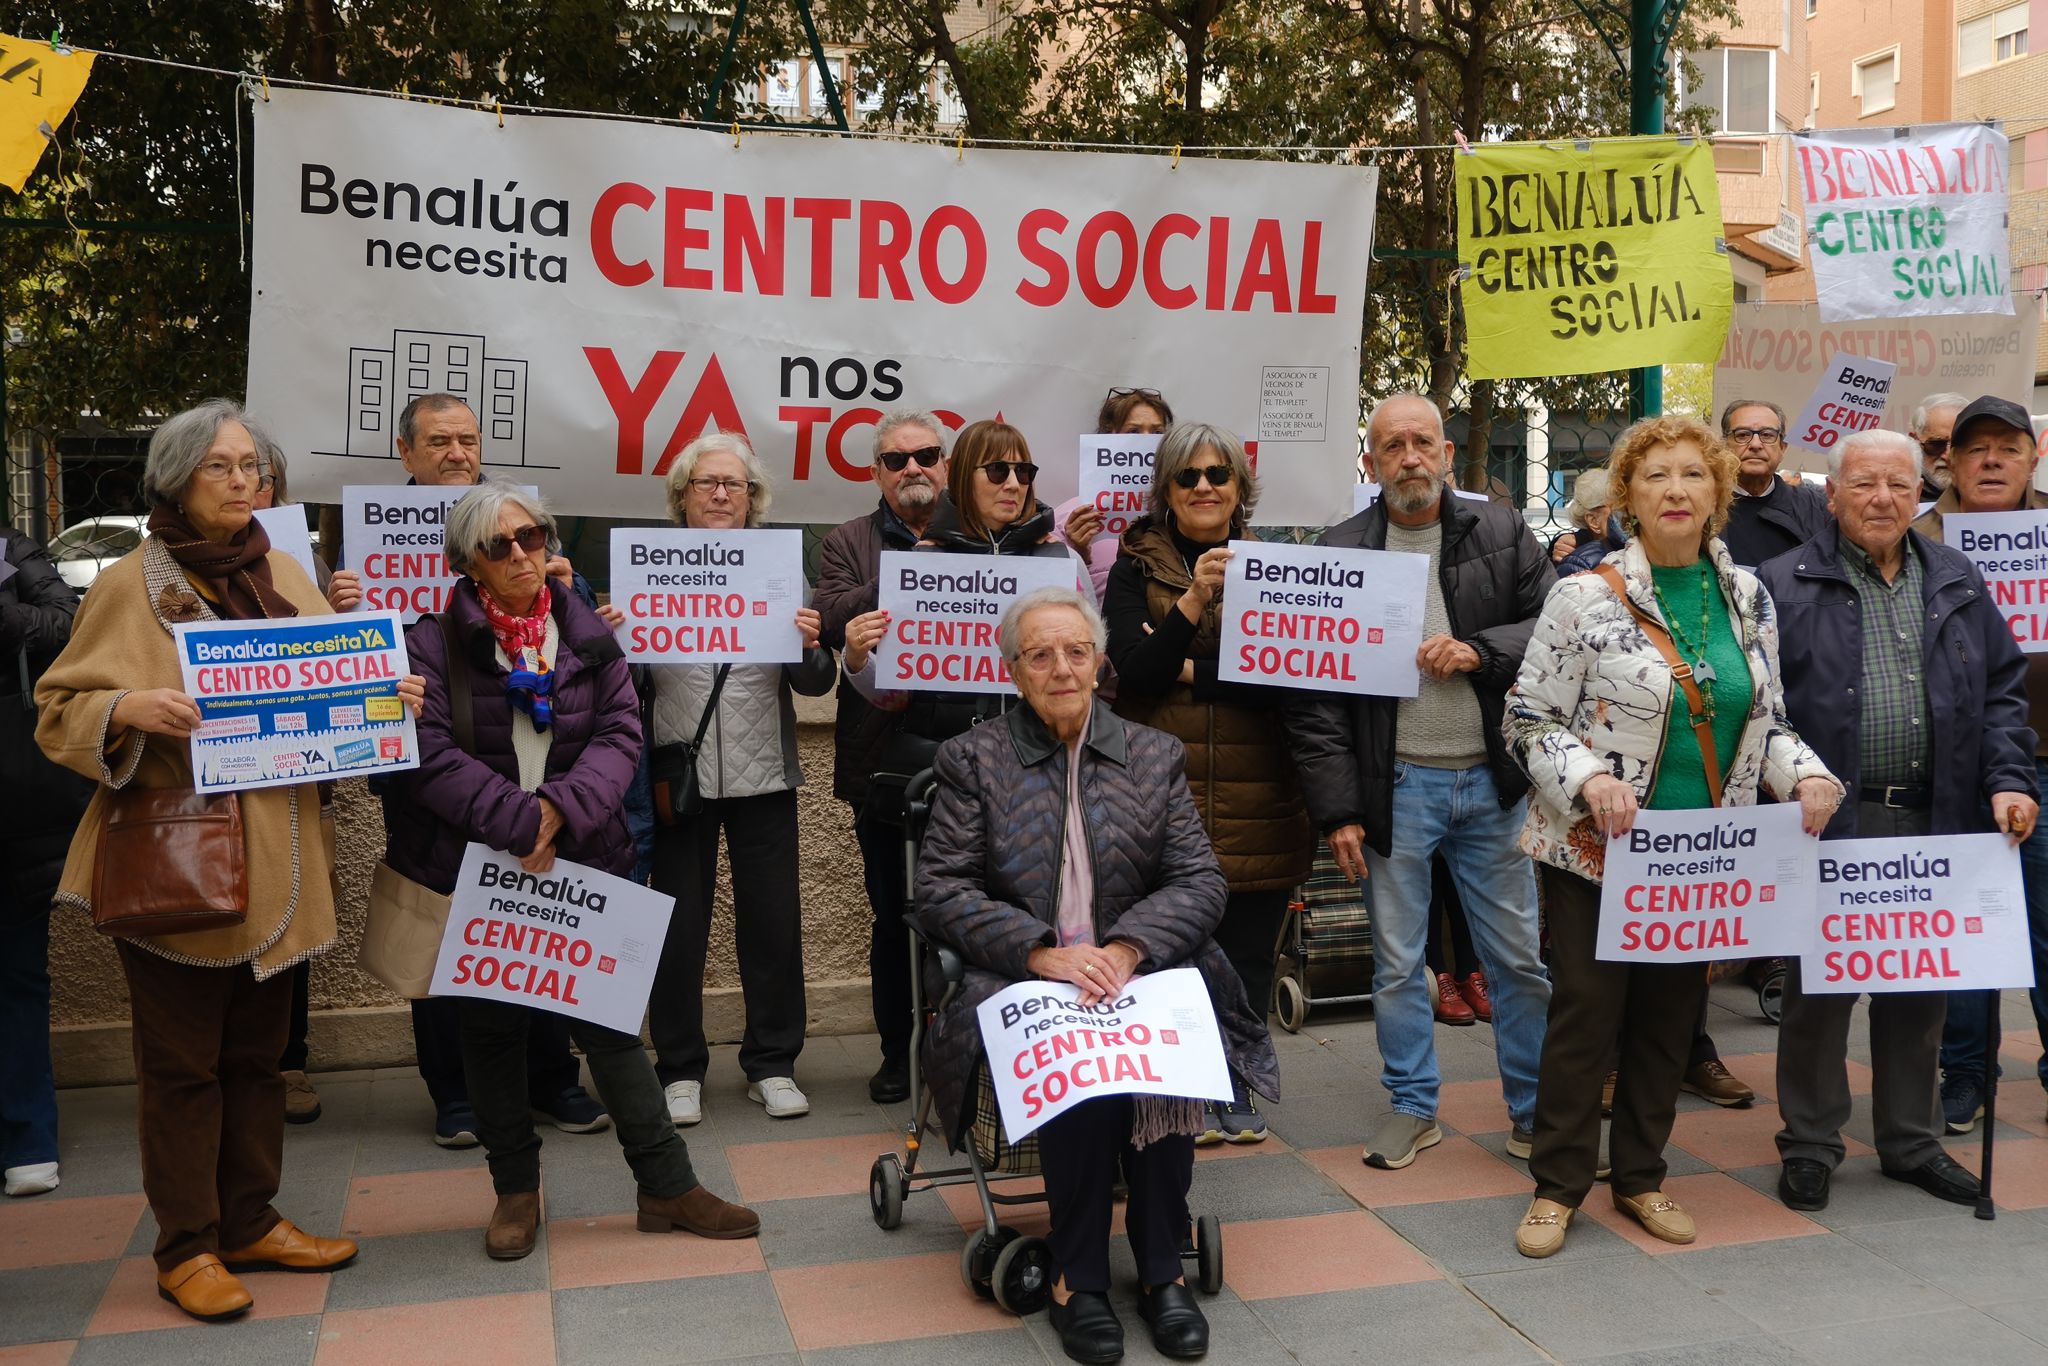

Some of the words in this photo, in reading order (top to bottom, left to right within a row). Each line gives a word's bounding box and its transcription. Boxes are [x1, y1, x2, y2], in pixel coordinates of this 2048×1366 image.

[301, 164, 569, 237] Benalúa
[1468, 163, 1705, 238] BENALÚA
[1815, 206, 1946, 256] CENTRO
[366, 237, 568, 284] necesita
[590, 182, 987, 304] CENTRO
[1015, 208, 1337, 314] SOCIAL
[1477, 240, 1619, 295] CENTRO
[1892, 249, 2005, 300] SOCIAL
[1550, 280, 1701, 340] SOCIAL
[780, 356, 904, 402] nos
[1838, 366, 1892, 394] Benal
[582, 346, 757, 476] YA
[1818, 402, 1881, 432] CENTR
[382, 529, 445, 546] necesi
[630, 541, 745, 566] Benalúa
[647, 571, 727, 586] necesita
[1245, 558, 1364, 589] Benalúa
[1976, 554, 2048, 573] necesit
[900, 568, 1017, 595] Benalúa
[630, 592, 746, 619] CENTRO
[916, 598, 998, 615] necesita
[1259, 590, 1343, 609] necesita
[630, 625, 746, 653] SOCIAL
[1240, 610, 1360, 645] CENTRO
[197, 665, 292, 694] CENTRO
[299, 653, 396, 687] SOCIAL
[895, 652, 1012, 683] SOCIAL
[1238, 644, 1357, 682] SOCIAL
[307, 692, 330, 701] Juntos,
[332, 690, 353, 698] somos
[199, 719, 248, 729] ONCENTRACIONES
[234, 725, 257, 733] Rodrigo
[220, 756, 256, 764] COLABORA
[273, 752, 301, 762] CENTRO
[300, 749, 325, 764] YA
[274, 760, 302, 770] SOCIAL
[1629, 821, 1757, 854] Benalúa
[1647, 855, 1736, 876] necesita
[1819, 851, 1951, 883] Benalúa
[478, 862, 608, 914] Benalúa
[1624, 878, 1753, 913] CENTRO
[1840, 885, 1933, 906] necesita
[489, 896, 581, 929] necesita
[1821, 909, 1956, 943] CENTRO
[463, 917, 593, 967] CENTRO
[1620, 916, 1749, 952] SOCIAL
[452, 954, 579, 1006] SOCIAL
[1824, 948, 1961, 982] SOCIAL
[1024, 1014, 1122, 1040] necesita
[1012, 1023, 1152, 1080] CENTRO
[1022, 1053, 1163, 1119] SOCIAL
